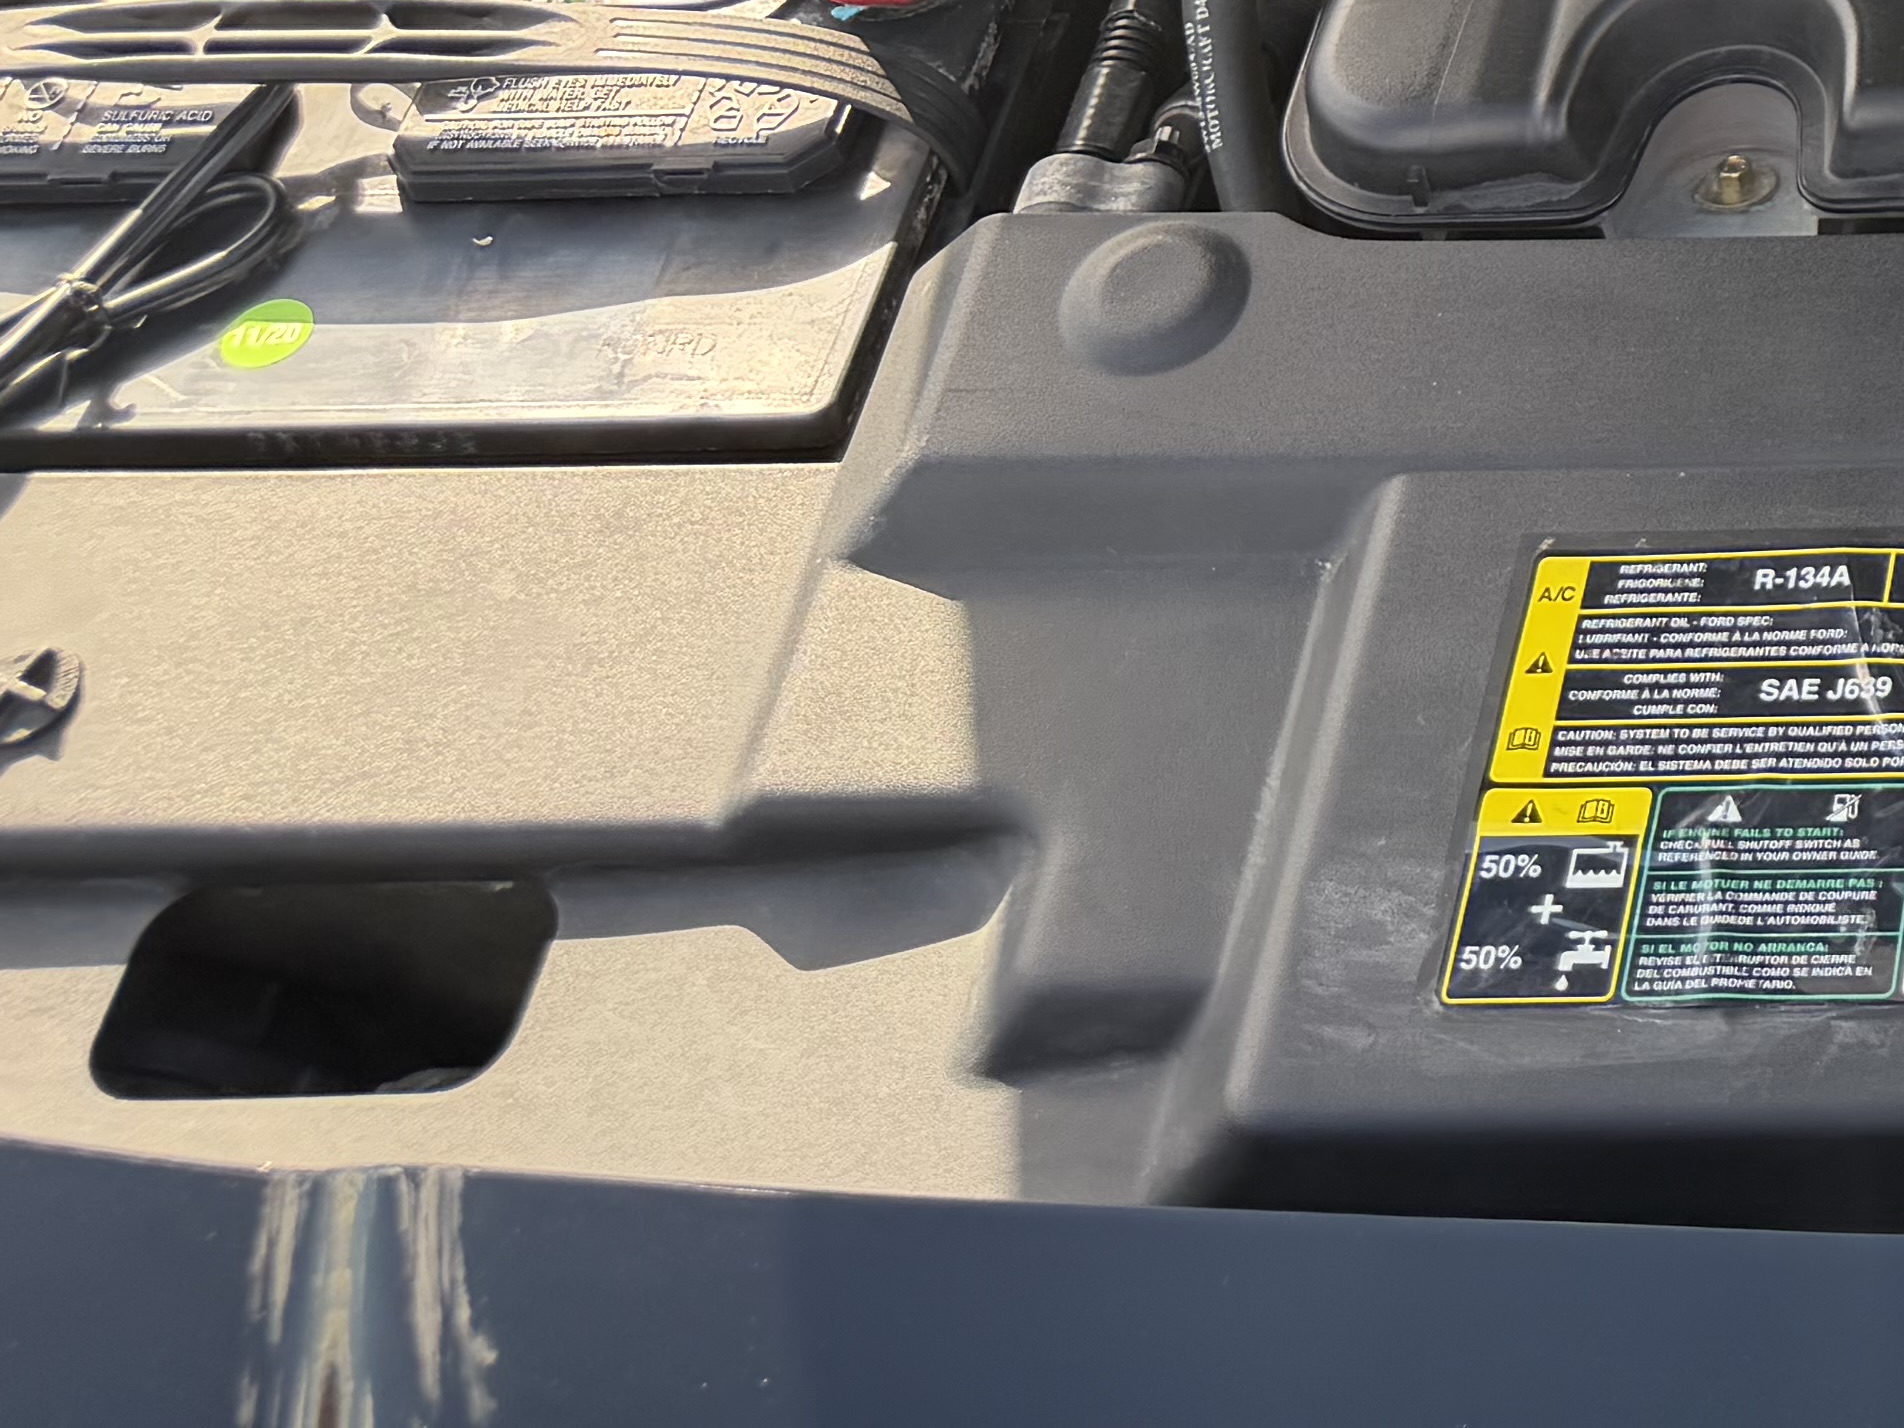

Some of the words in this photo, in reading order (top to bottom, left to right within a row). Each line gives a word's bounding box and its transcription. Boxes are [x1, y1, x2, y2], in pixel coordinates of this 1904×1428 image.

[503, 77, 548, 89] FLUSH
[552, 78, 587, 88] EYES
[102, 110, 173, 121] SULFURIC
[176, 110, 213, 121] ACID
[82, 144, 124, 154] SEVERE
[126, 143, 168, 153] BURNS
[1754, 566, 1850, 589] R-134A
[1538, 586, 1576, 602] A/C
[1604, 594, 1702, 604] REFRIGERANTE:
[1582, 617, 1668, 628] REFRIGERANT
[1671, 617, 1690, 627] OIL
[1700, 616, 1735, 626] FORD
[1737, 616, 1773, 626] SPEC:
[1660, 631, 1729, 642] CONFORME
[1745, 631, 1760, 640] LA
[1763, 630, 1807, 640] NORME
[1810, 628, 1848, 639] FORD:
[1650, 647, 1681, 658] PARA
[1624, 673, 1687, 685] COMPLIES
[1689, 672, 1725, 683] WITH:
[1568, 690, 1638, 700] CONFORME
[1653, 688, 1668, 699] LA
[1671, 687, 1721, 699] NORME:
[1759, 678, 1821, 700] SAE
[1827, 676, 1893, 700] J639
[1633, 704, 1684, 716] CUMPLE
[1687, 703, 1718, 715] CON:
[1558, 730, 1616, 741] CAUTION:
[1619, 729, 1670, 740] SYSTEM
[1673, 728, 1689, 739] TO
[1692, 728, 1709, 739] BE
[1712, 726, 1765, 738] SERVICE
[1768, 726, 1785, 737] BY
[1788, 725, 1853, 736] QUALIFIED
[1554, 746, 1584, 756] MISE
[1587, 745, 1604, 756] EN
[1607, 744, 1655, 755] GARDE:
[1657, 744, 1675, 755] NE
[1677, 743, 1732, 754] CONFIER
[1850, 741, 1868, 751] UN
[1551, 757, 1637, 772] PRECAUCIÓN:
[1639, 761, 1655, 771] EL
[1657, 760, 1712, 771] SISTEMA
[1714, 759, 1749, 770] DEBE
[1751, 758, 1776, 769] SER
[1845, 756, 1879, 767] SOLO
[1734, 828, 1771, 838] FAILS
[1774, 828, 1793, 837] TO
[1795, 827, 1844, 837] START:
[1740, 851, 1753, 861] IN
[1755, 851, 1789, 861] YOUR
[1792, 850, 1838, 860] OWNER
[1479, 853, 1542, 878] 50%
[1670, 880, 1687, 890] LE
[1753, 879, 1771, 890] NE
[1776, 879, 1844, 889] DEMARRE
[1848, 878, 1876, 888] PAS
[1640, 944, 1655, 954] SI
[1658, 944, 1675, 954] EL
[1733, 942, 1753, 952] NO
[1758, 942, 1828, 953] ARRANCA:
[1460, 944, 1522, 970] 50%
